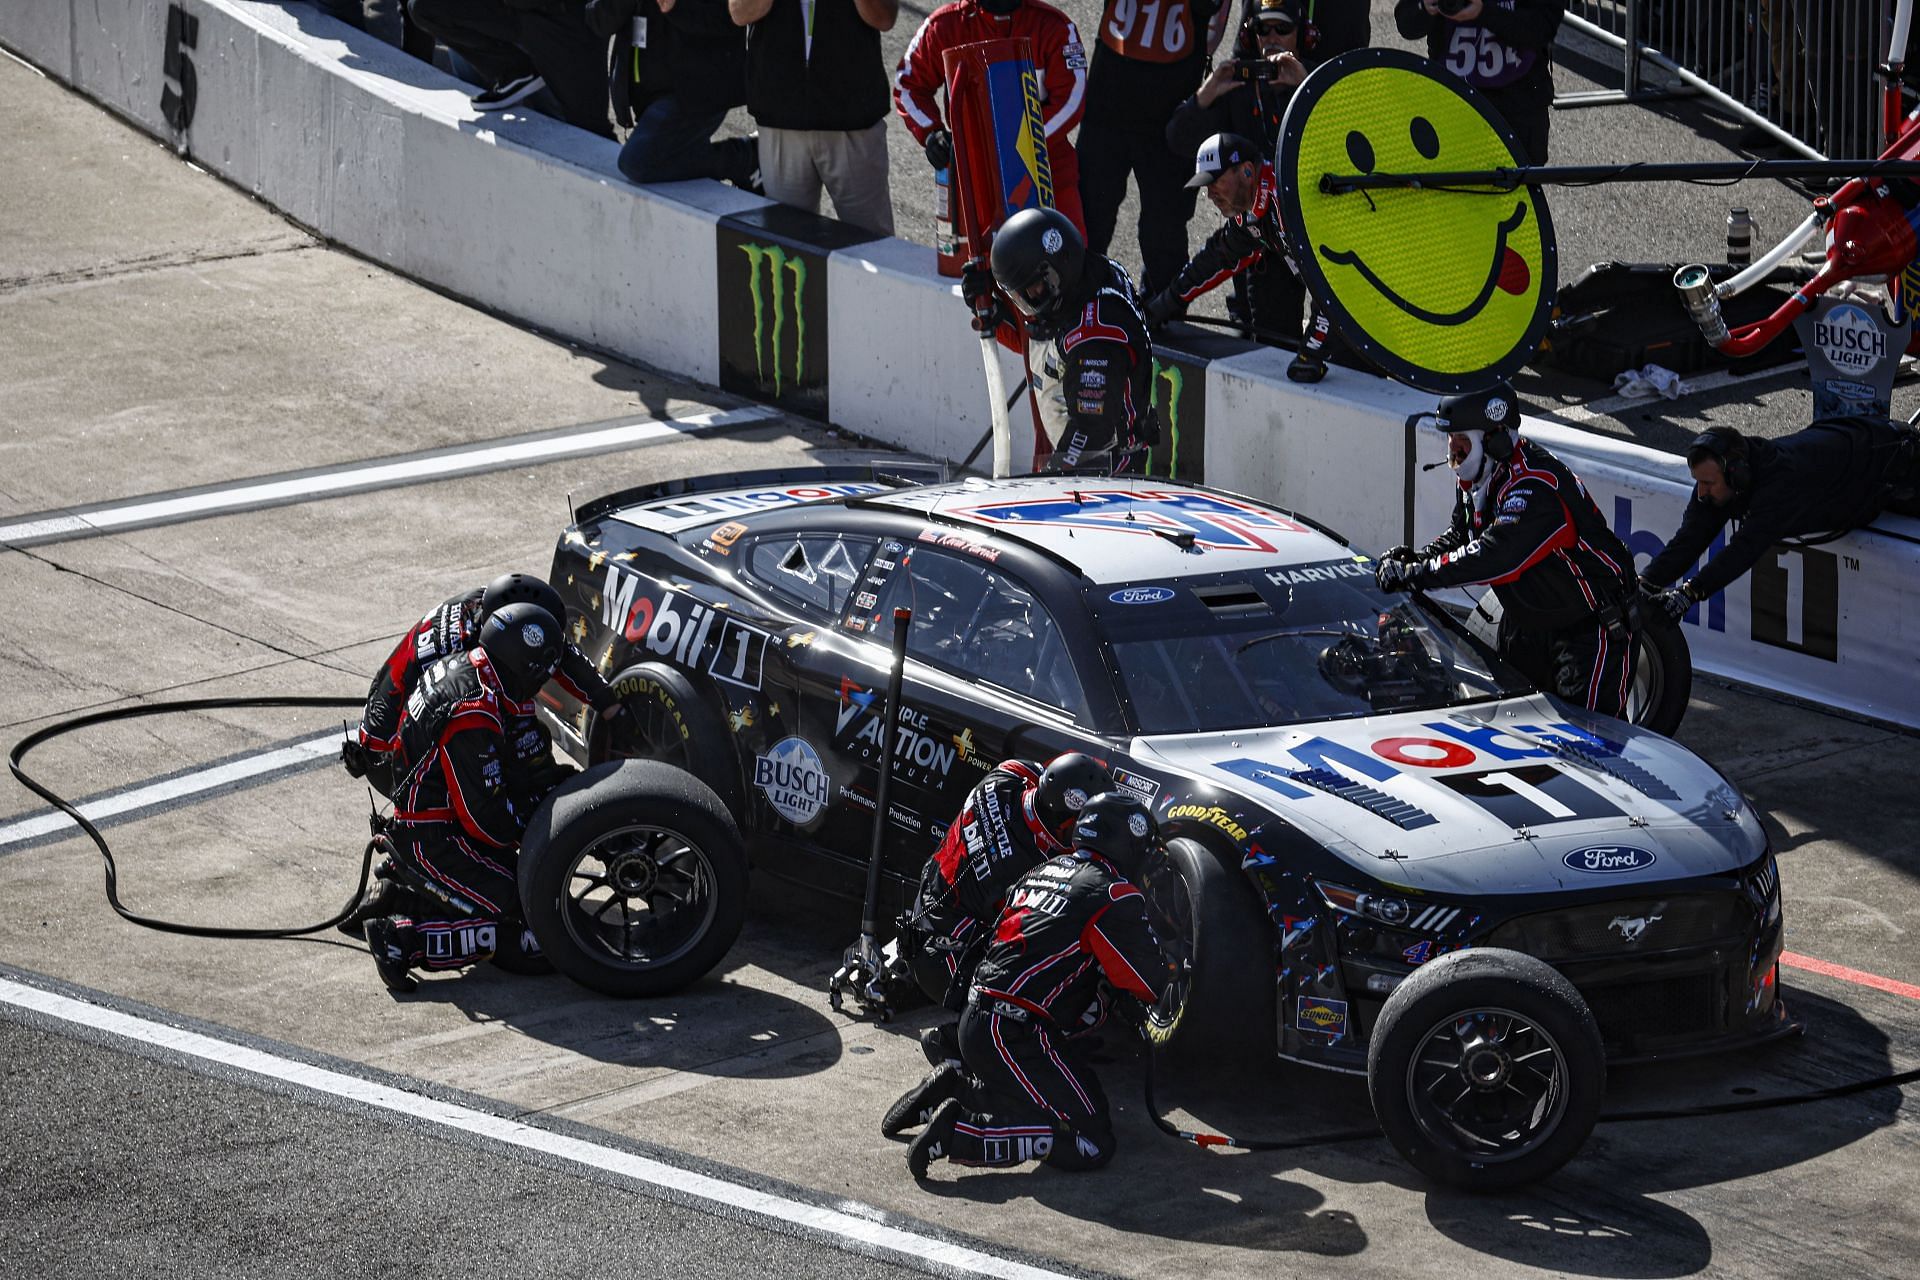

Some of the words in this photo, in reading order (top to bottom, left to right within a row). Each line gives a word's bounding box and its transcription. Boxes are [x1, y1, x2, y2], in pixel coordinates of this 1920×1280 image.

[1108, 0, 1186, 52] 916
[160, 4, 199, 131] 5
[1022, 72, 1055, 211] SUNOCO
[1306, 315, 1330, 350] Mobil
[1815, 323, 1886, 356] BUSCH
[1830, 350, 1871, 366] LIGHT
[1430, 546, 1465, 572] Mobil
[1843, 556, 1860, 571] TM
[1265, 562, 1375, 586] HARVICK
[1123, 588, 1163, 602] Ford
[602, 564, 716, 669] Mobil
[612, 677, 690, 740] GOODYEAR
[967, 756, 993, 772] POWER
[1211, 721, 1652, 802] Mobil
[755, 757, 829, 804] BUSCH
[1126, 775, 1154, 793] NASCAR
[774, 790, 815, 812] LIGHT
[839, 785, 877, 809] Performanc
[1476, 771, 1578, 819] 1
[888, 806, 921, 829] Protection
[984, 781, 1014, 859] DOOLITTLE
[1167, 804, 1248, 842] GOODYEAR
[930, 825, 946, 838] Clea
[1584, 847, 1639, 870] Ford
[1403, 940, 1432, 965] 4
[1301, 1009, 1344, 1024] SUNOCO
